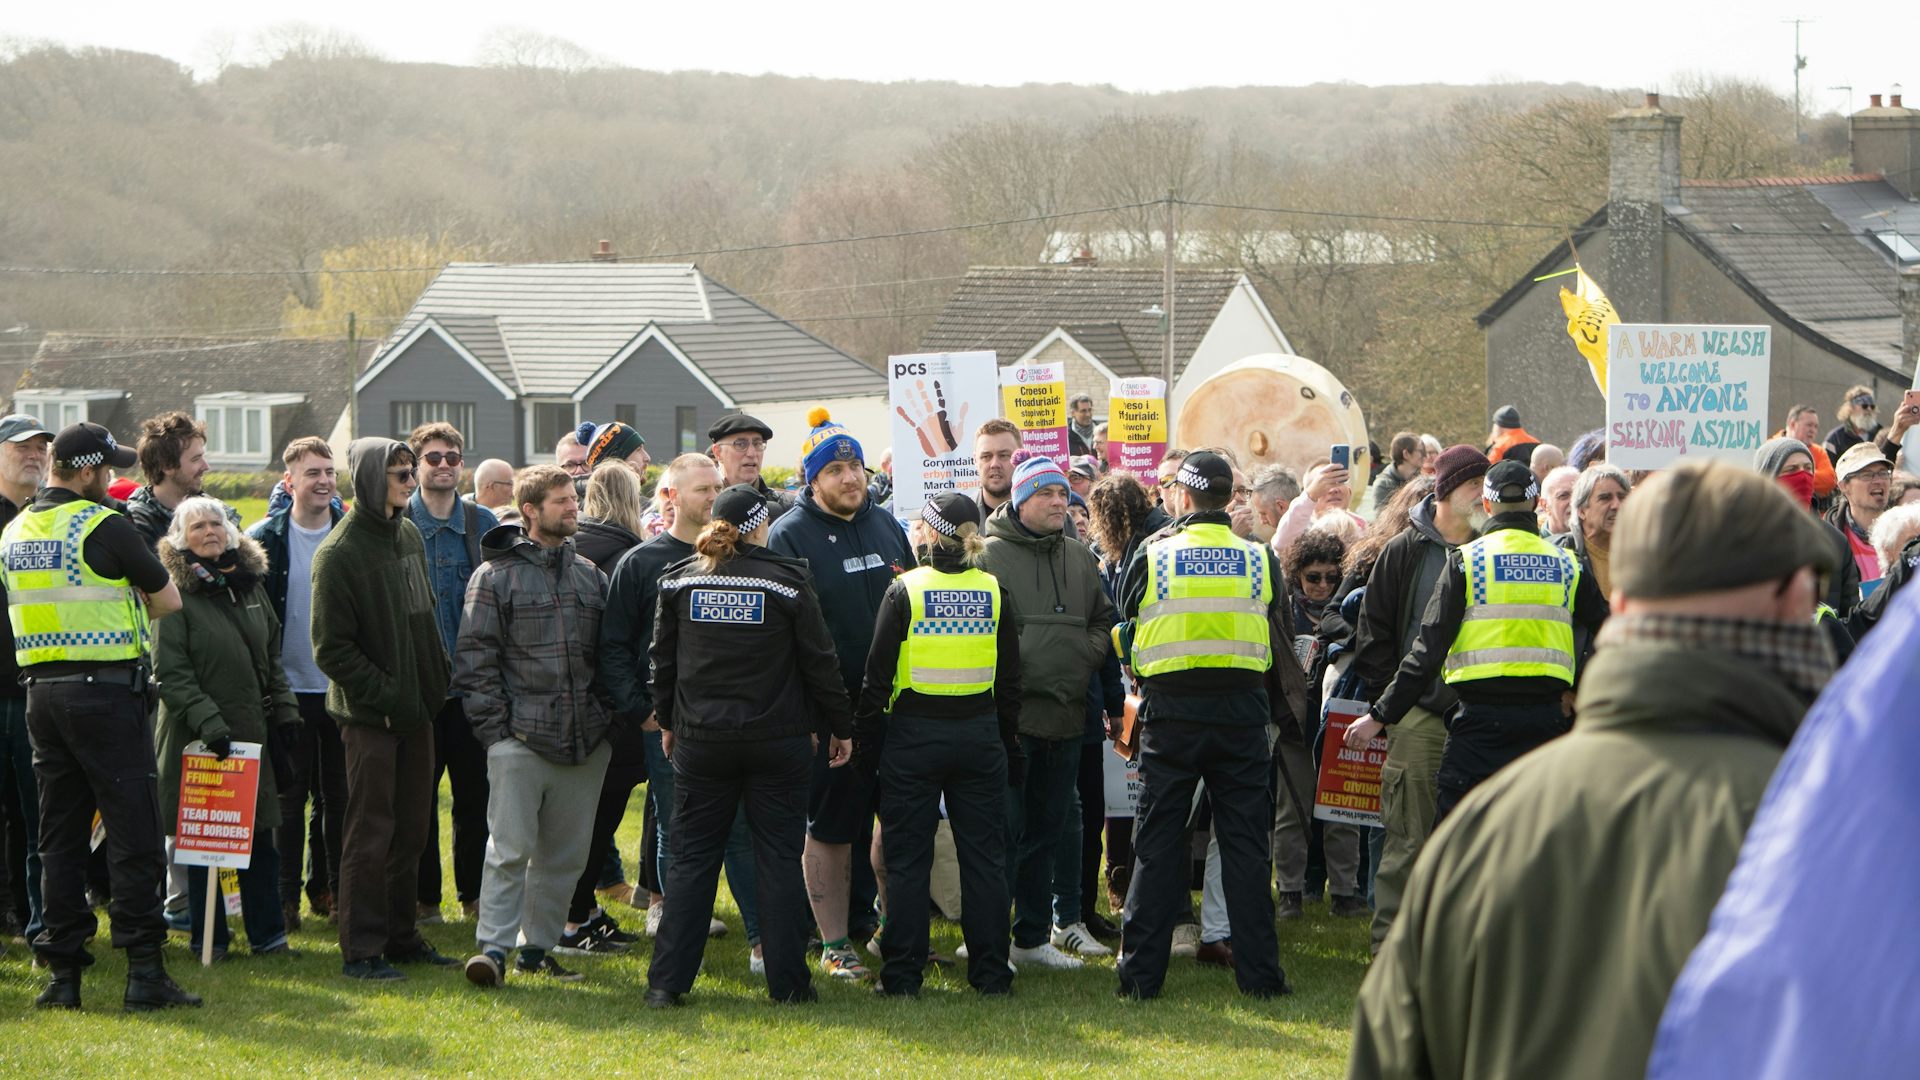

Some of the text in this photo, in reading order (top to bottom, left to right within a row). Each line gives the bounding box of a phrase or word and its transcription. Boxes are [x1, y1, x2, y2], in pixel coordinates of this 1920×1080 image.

[1617, 330, 1766, 359] A WARM WELSH
[894, 363, 927, 379] pcs
[1640, 361, 1721, 384] WELCOME
[1020, 384, 1052, 396] Croeso i
[1015, 396, 1060, 407] ffoaduriaid:
[1624, 381, 1748, 413] TO ANYONE
[1146, 400, 1149, 409] i
[1023, 431, 1058, 442] Refugees
[1611, 419, 1761, 455] SEEKING ASYLUM
[1024, 444, 1060, 453] Welcome:
[923, 470, 952, 479] erbyn
[1144, 468, 1158, 478] righ
[924, 480, 954, 490] March
[12, 541, 57, 554] HEDDLU
[1182, 549, 1240, 561] HEDDLU
[14, 556, 53, 570] POLICE
[1184, 562, 1238, 574] POLICE
[1500, 556, 1556, 568] HEDDLU
[1504, 569, 1554, 581] POLICE
[698, 592, 756, 606] HEDDLU
[930, 592, 986, 602] HEDDLU
[701, 607, 752, 620] POLICE
[934, 606, 984, 617] POLICE
[1337, 748, 1382, 764] TO TORY
[238, 759, 246, 772] Y
[186, 771, 224, 786] FFINIAU
[1344, 780, 1380, 796] ORIAID
[1321, 792, 1369, 808] HILIAETH
[182, 808, 241, 822] TEAR DOWN
[181, 822, 250, 839] THE BORDERS
[180, 837, 194, 846] Free
[196, 838, 228, 849] movement
[230, 840, 239, 849] for
